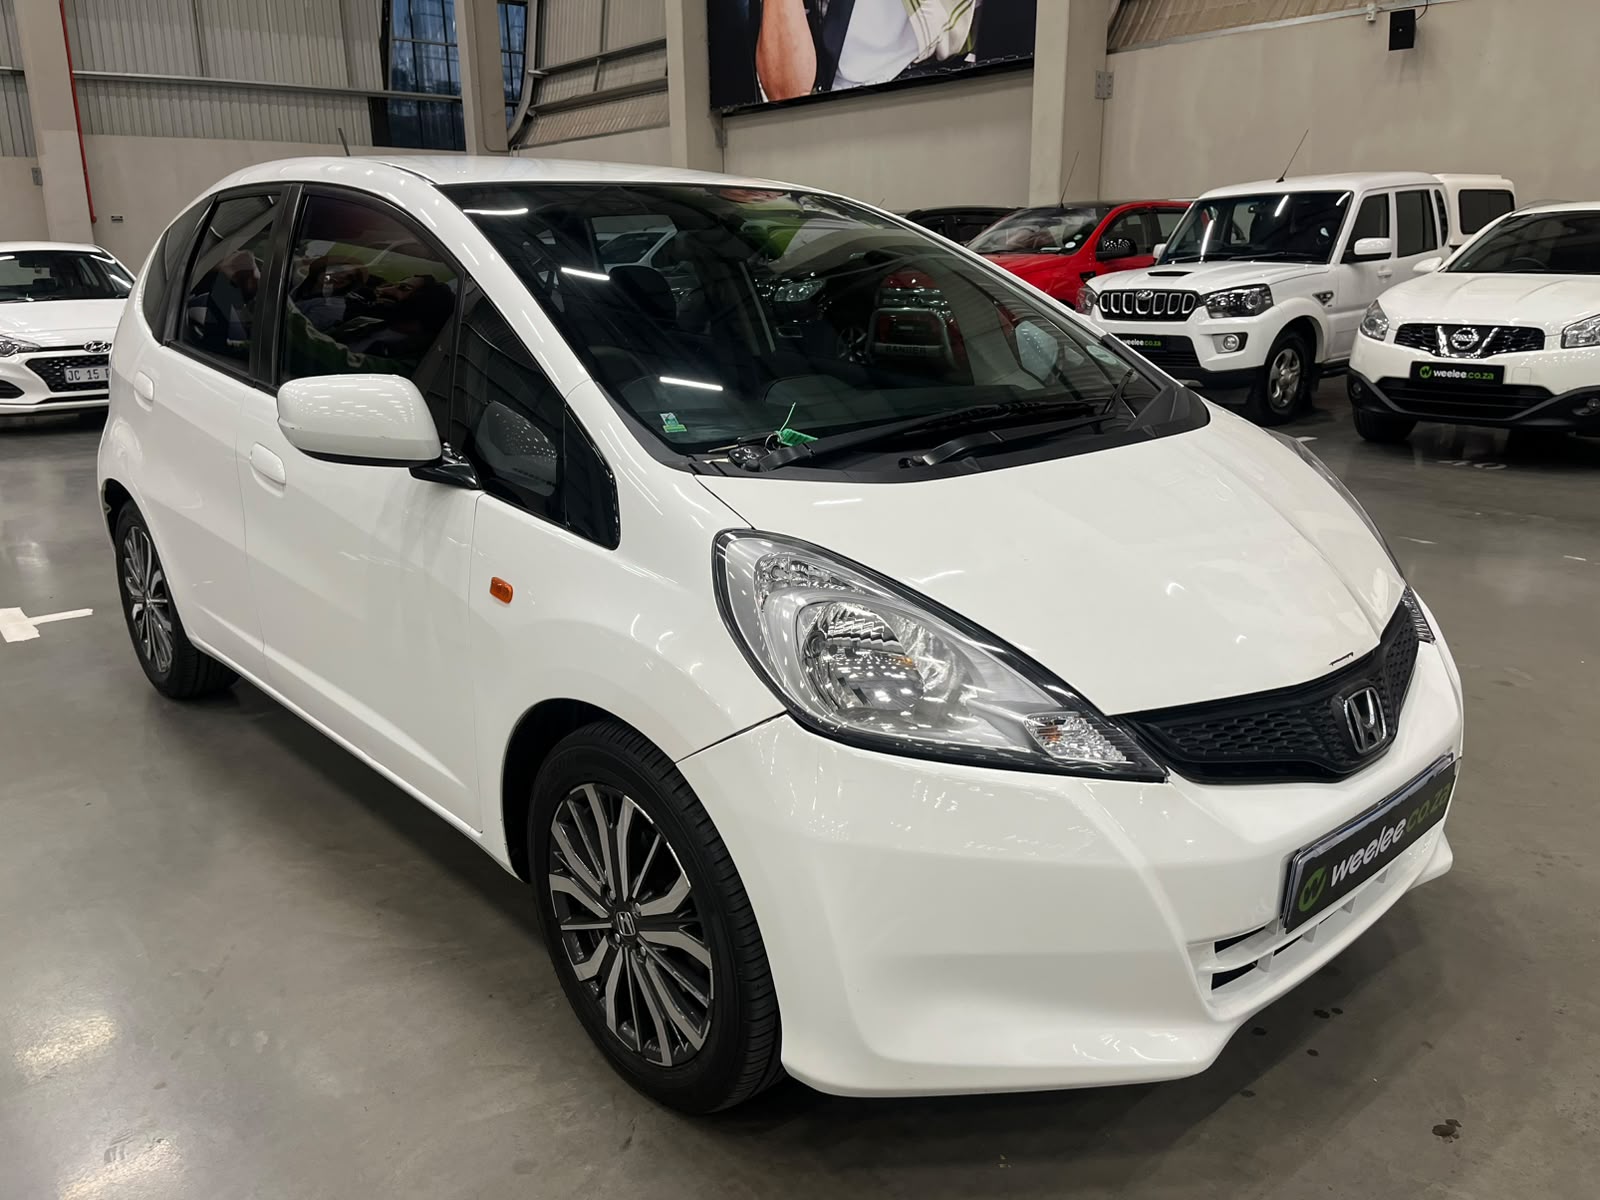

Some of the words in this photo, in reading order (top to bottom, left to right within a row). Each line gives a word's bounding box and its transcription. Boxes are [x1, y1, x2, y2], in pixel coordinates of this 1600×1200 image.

[68, 369, 81, 381] JC
[86, 368, 100, 380] 15
[1433, 368, 1495, 380] weelee.co.za
